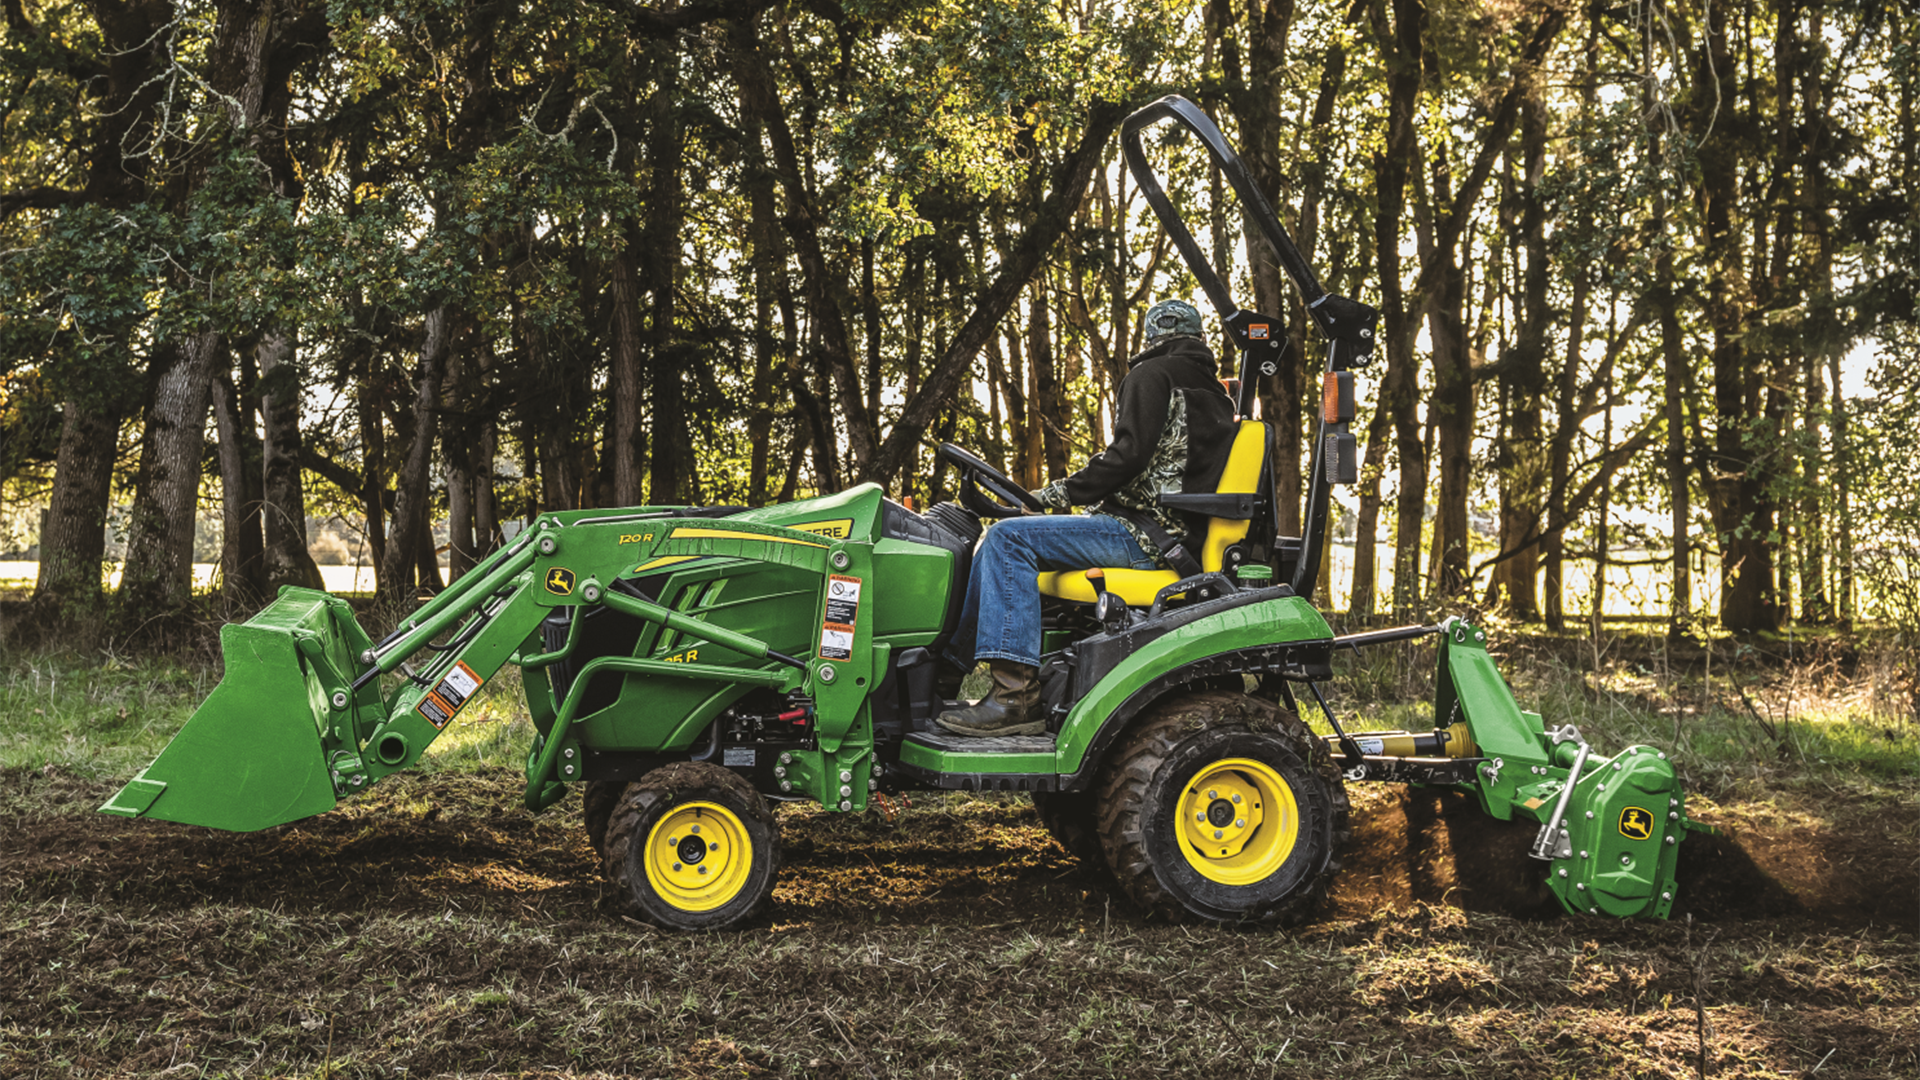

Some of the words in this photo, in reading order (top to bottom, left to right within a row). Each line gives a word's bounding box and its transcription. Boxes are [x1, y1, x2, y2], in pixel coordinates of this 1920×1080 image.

[804, 527, 842, 538] ERE
[619, 534, 642, 545] 120
[643, 533, 653, 542] R
[686, 650, 698, 663] R
